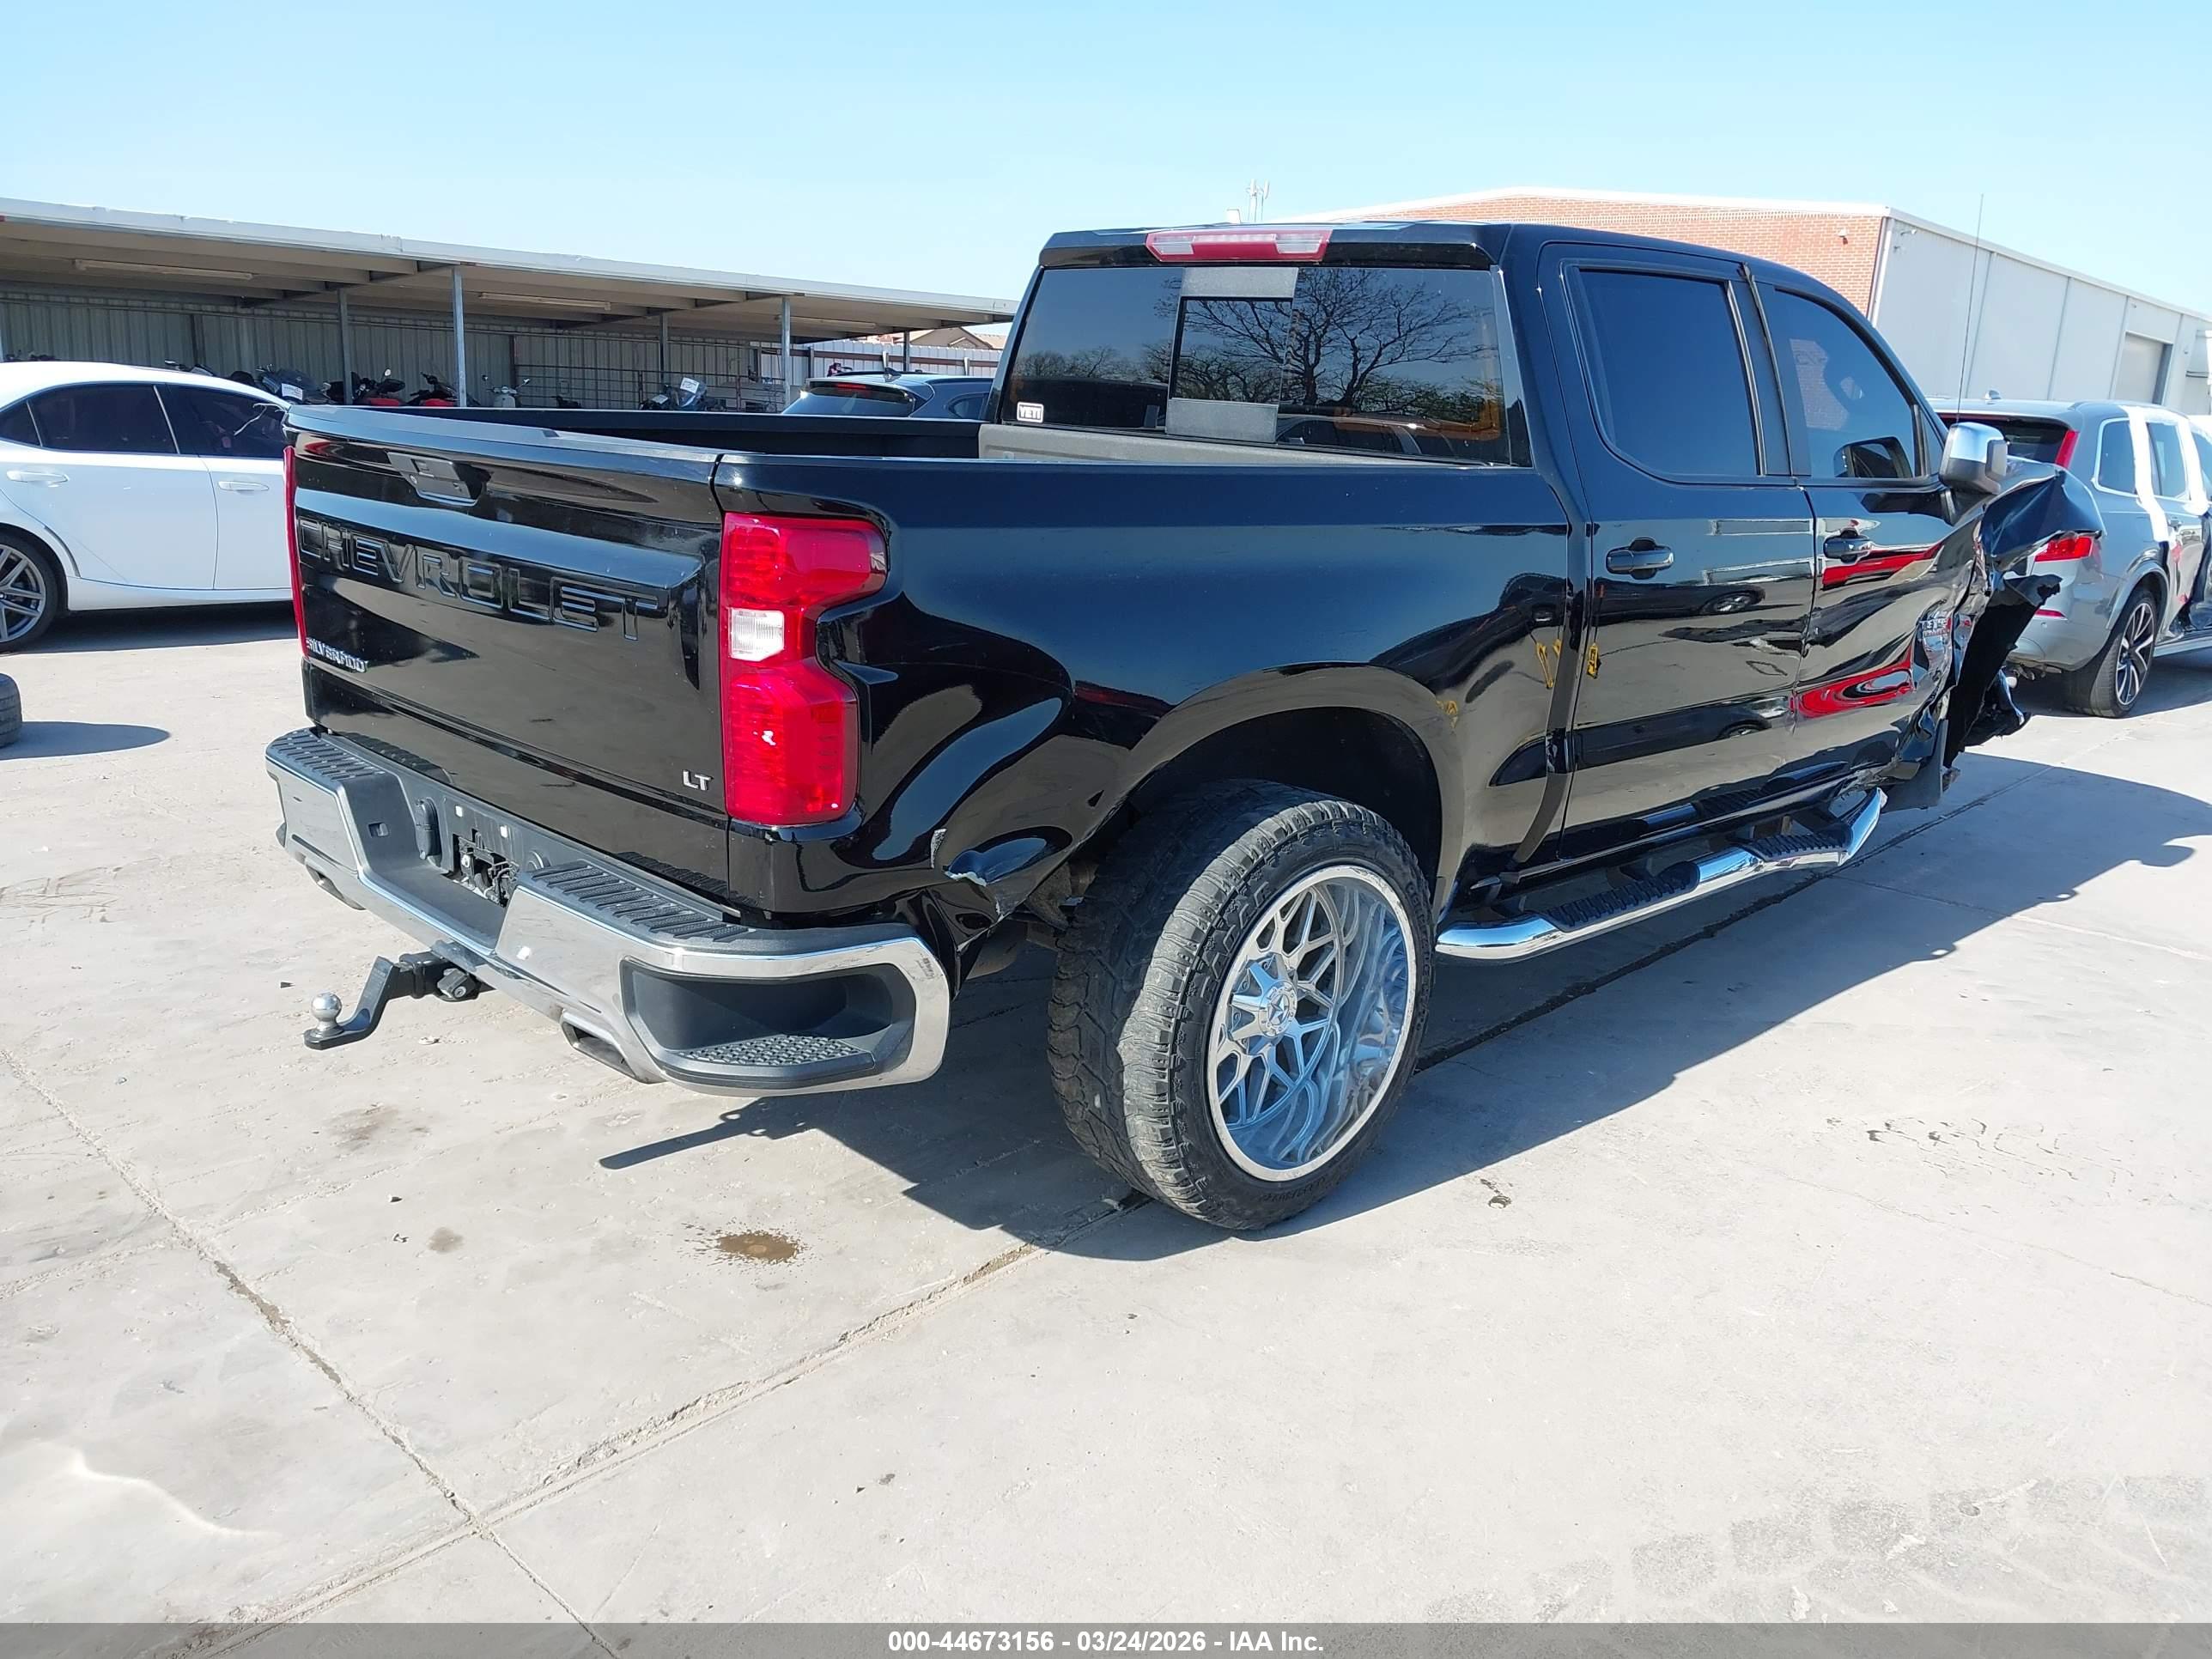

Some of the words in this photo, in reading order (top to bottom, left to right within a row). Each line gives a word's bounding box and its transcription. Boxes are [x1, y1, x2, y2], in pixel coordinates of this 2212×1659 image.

[1020, 405, 1042, 420] YETI
[295, 514, 659, 641] CHEVROLET
[305, 636, 369, 673] SILVERADO
[683, 769, 712, 791] LT
